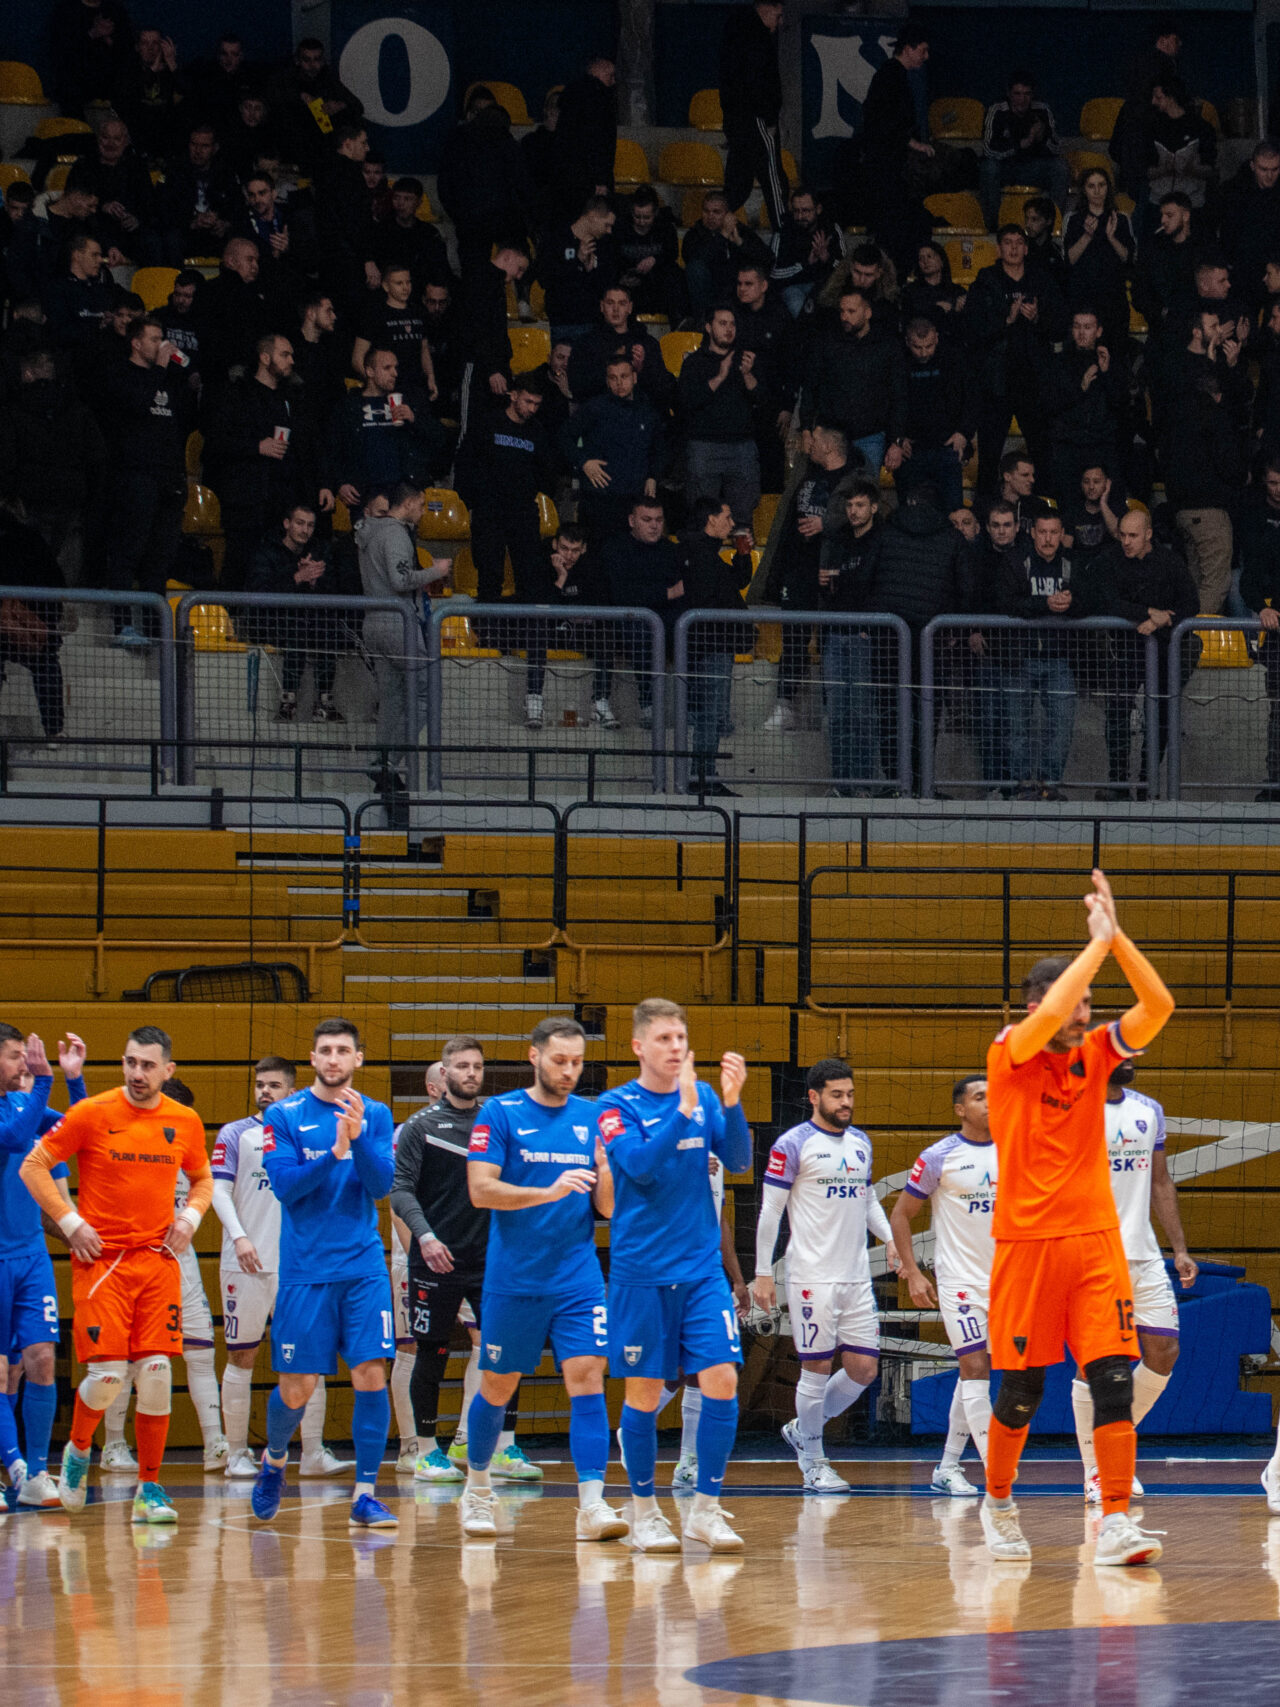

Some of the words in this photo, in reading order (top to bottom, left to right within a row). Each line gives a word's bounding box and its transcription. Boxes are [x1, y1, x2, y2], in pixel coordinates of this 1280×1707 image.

[339, 16, 451, 127] O
[1109, 1158, 1136, 1172] SK
[826, 1186, 859, 1199] PSK
[968, 1200, 995, 1213] PS
[225, 1314, 238, 1339] 20
[413, 1306, 430, 1334] 25
[1116, 1299, 1134, 1331] 12
[801, 1323, 819, 1348] 17
[958, 1316, 982, 1343] 10
